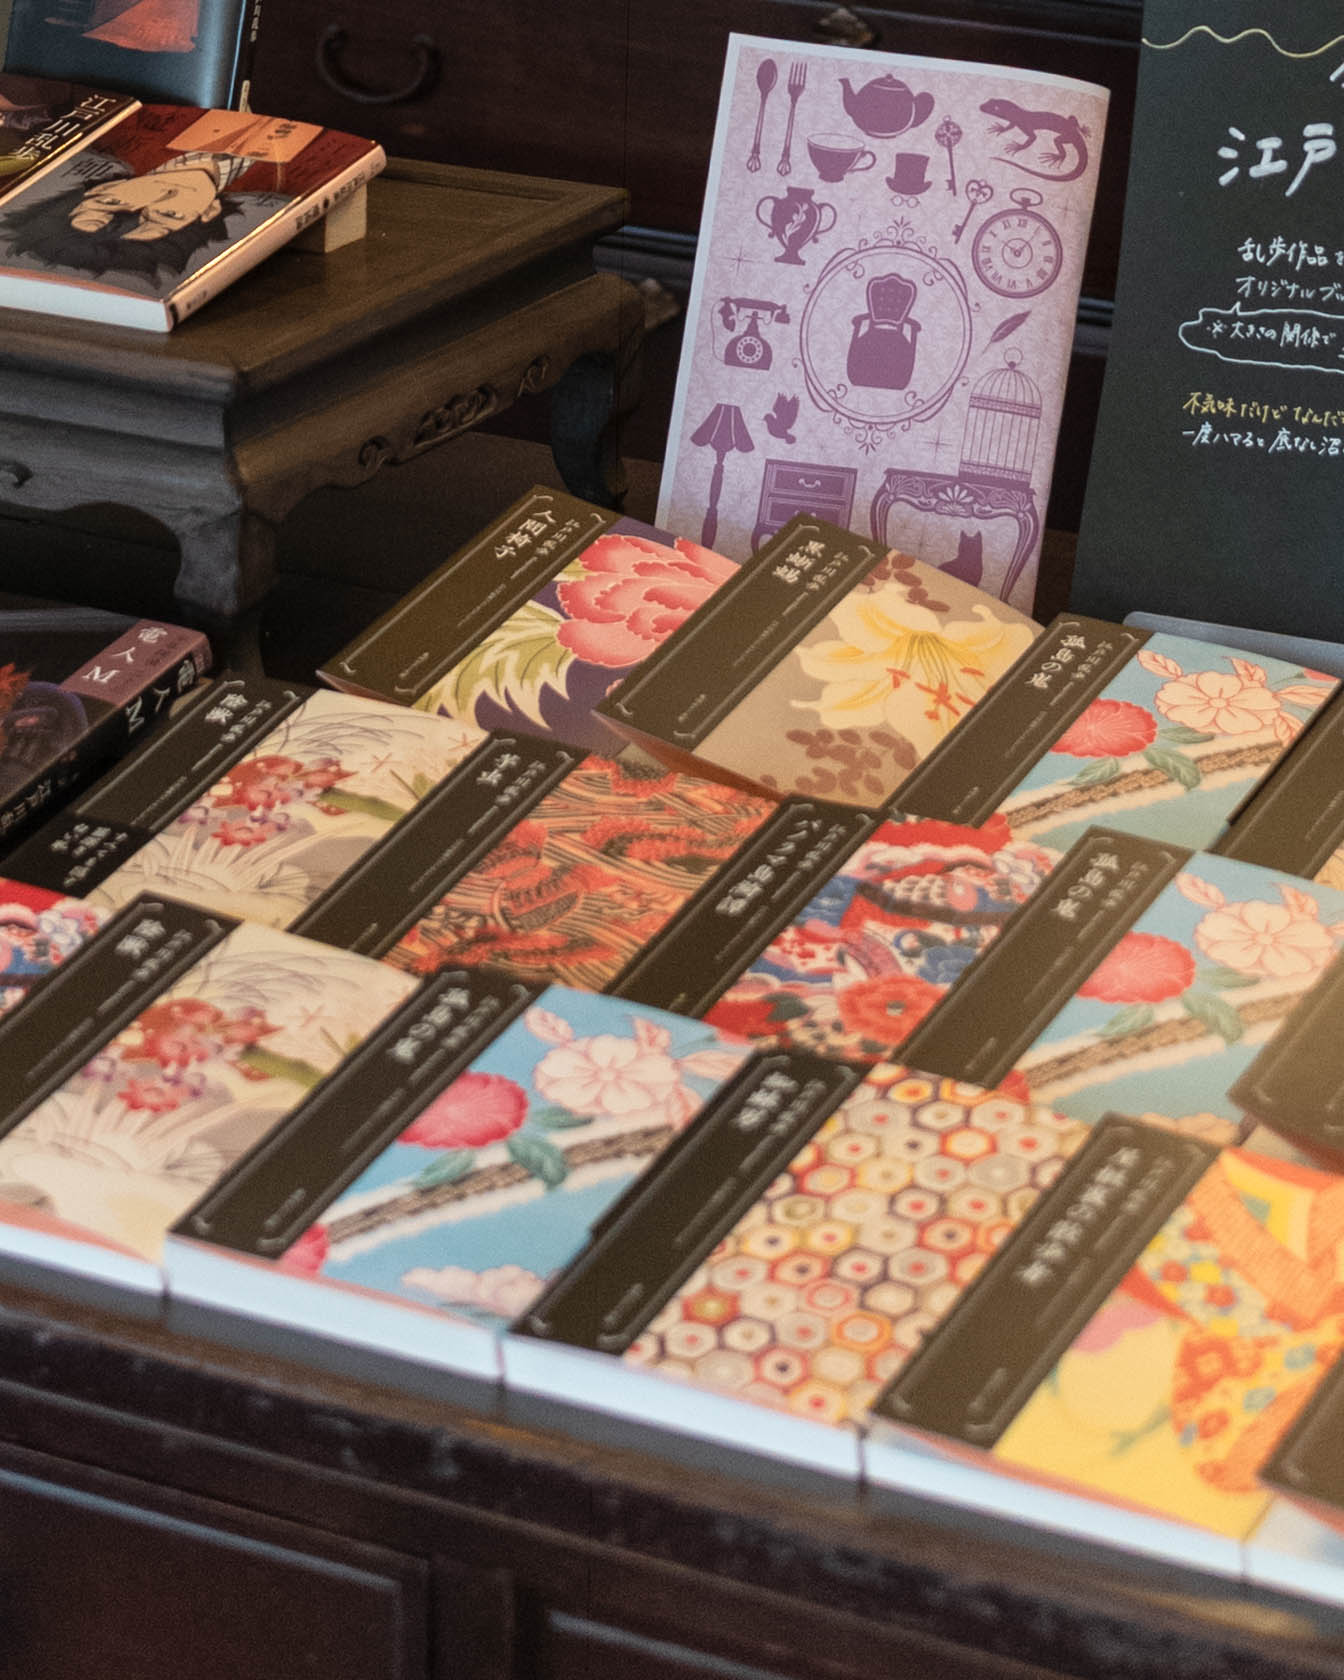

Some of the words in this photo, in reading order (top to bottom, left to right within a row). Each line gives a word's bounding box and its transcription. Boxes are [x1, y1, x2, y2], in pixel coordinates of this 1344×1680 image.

[12, 93, 117, 162] 江戸川乱歩
[1217, 123, 1337, 197] 江戸
[1183, 391, 1344, 428] 不気味だけどなんだ
[81, 625, 168, 685] 電人M
